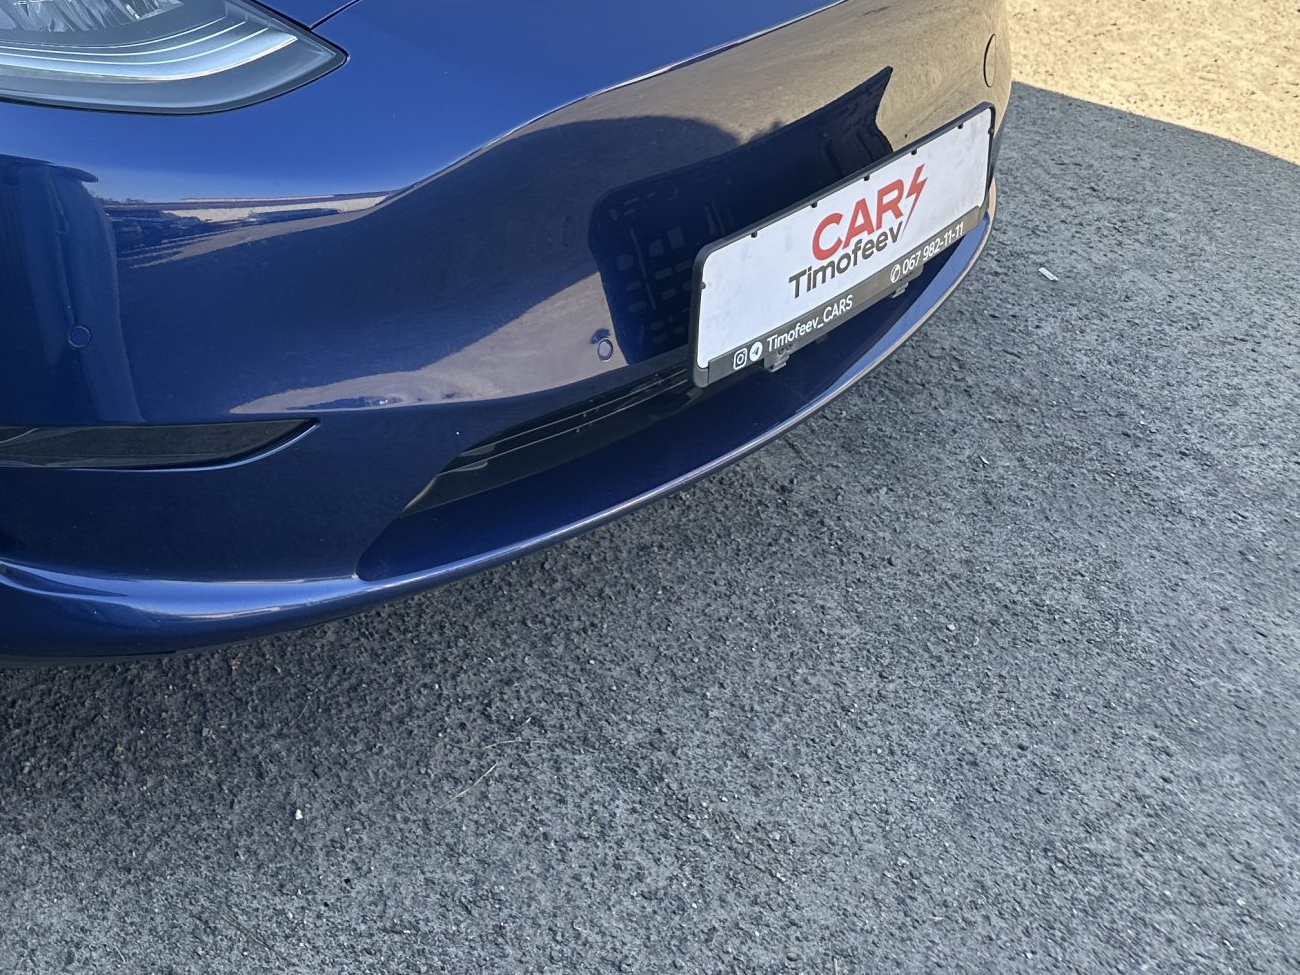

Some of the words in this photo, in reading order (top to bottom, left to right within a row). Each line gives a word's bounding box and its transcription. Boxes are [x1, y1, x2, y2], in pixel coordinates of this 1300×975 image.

[788, 221, 904, 300] Timofeev
[902, 251, 923, 275] 067
[766, 294, 853, 353] Timofeev_CARS
